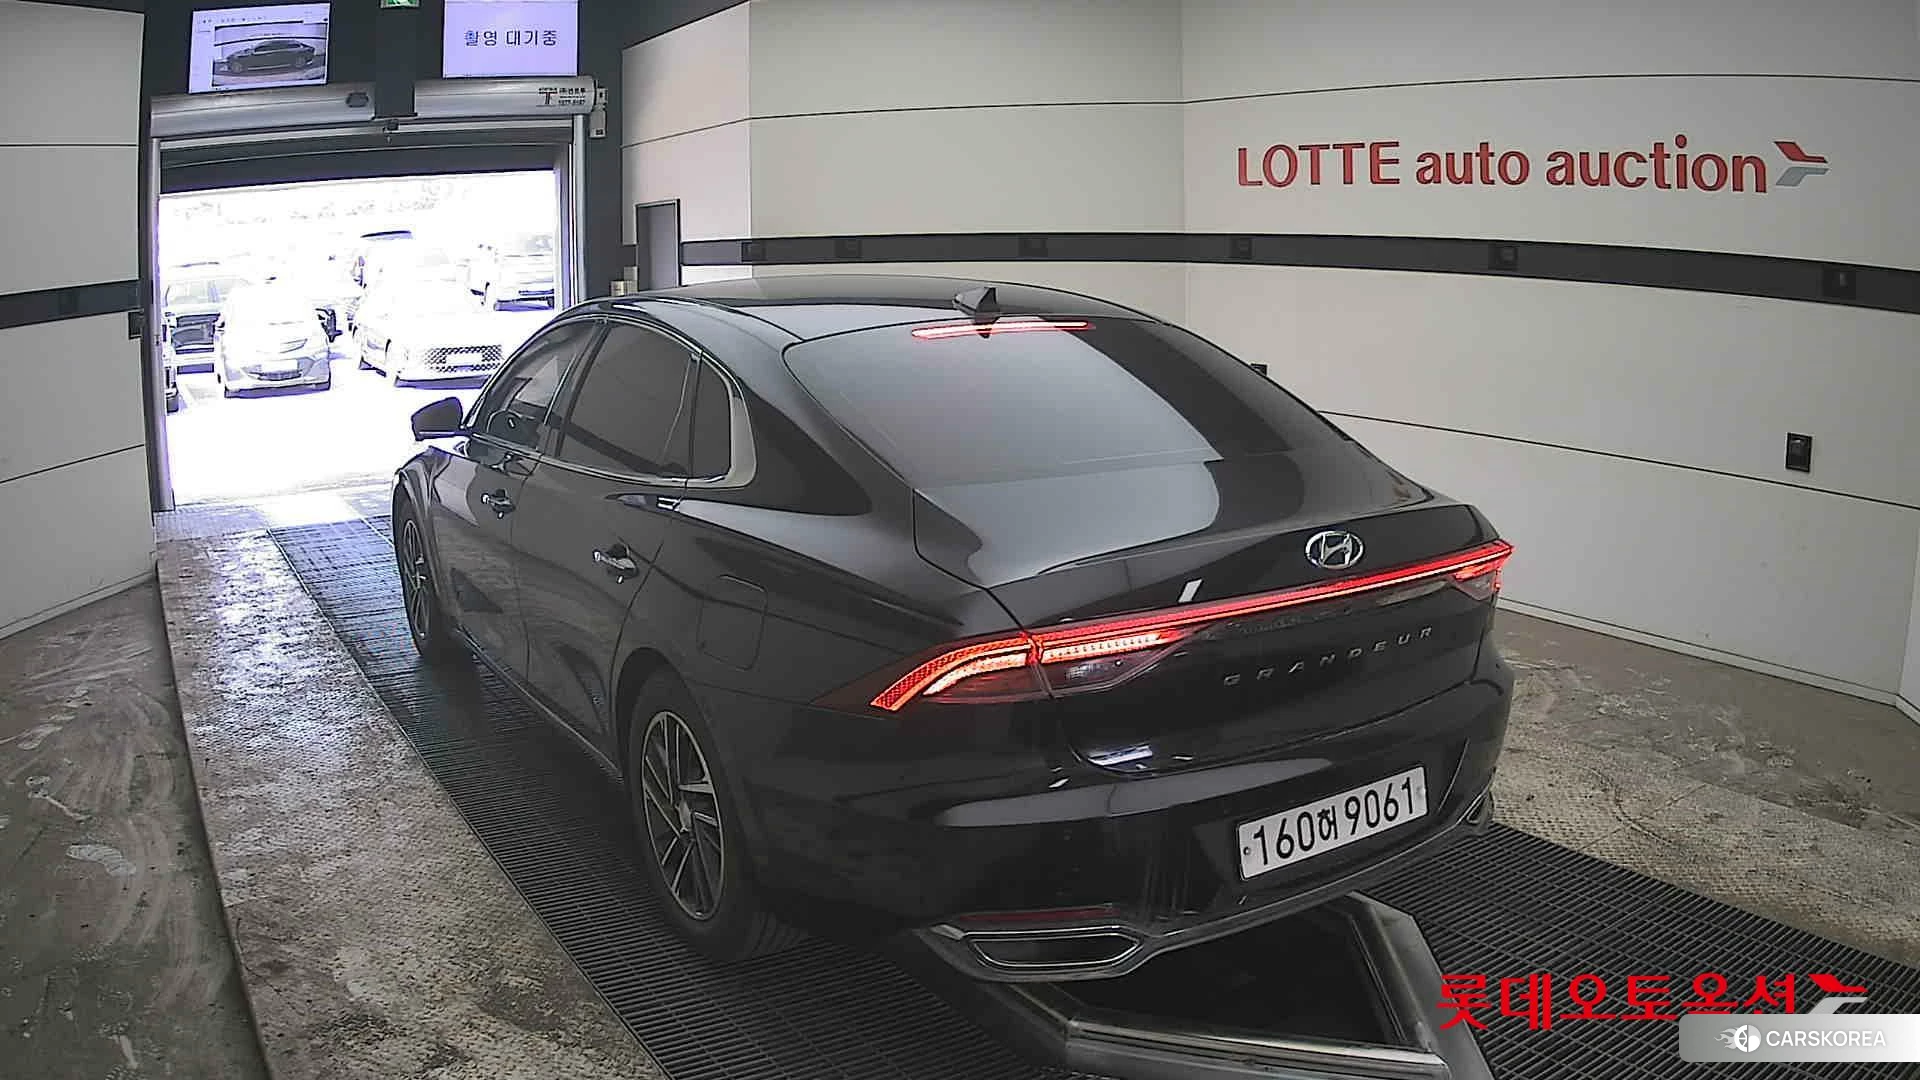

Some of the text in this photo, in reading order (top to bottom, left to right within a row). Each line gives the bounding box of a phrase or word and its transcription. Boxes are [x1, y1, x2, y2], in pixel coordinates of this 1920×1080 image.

[506, 30, 557, 47] 대기중
[1237, 134, 1768, 193] LOTTE auto auction
[1223, 625, 1433, 687] GRANDEUR
